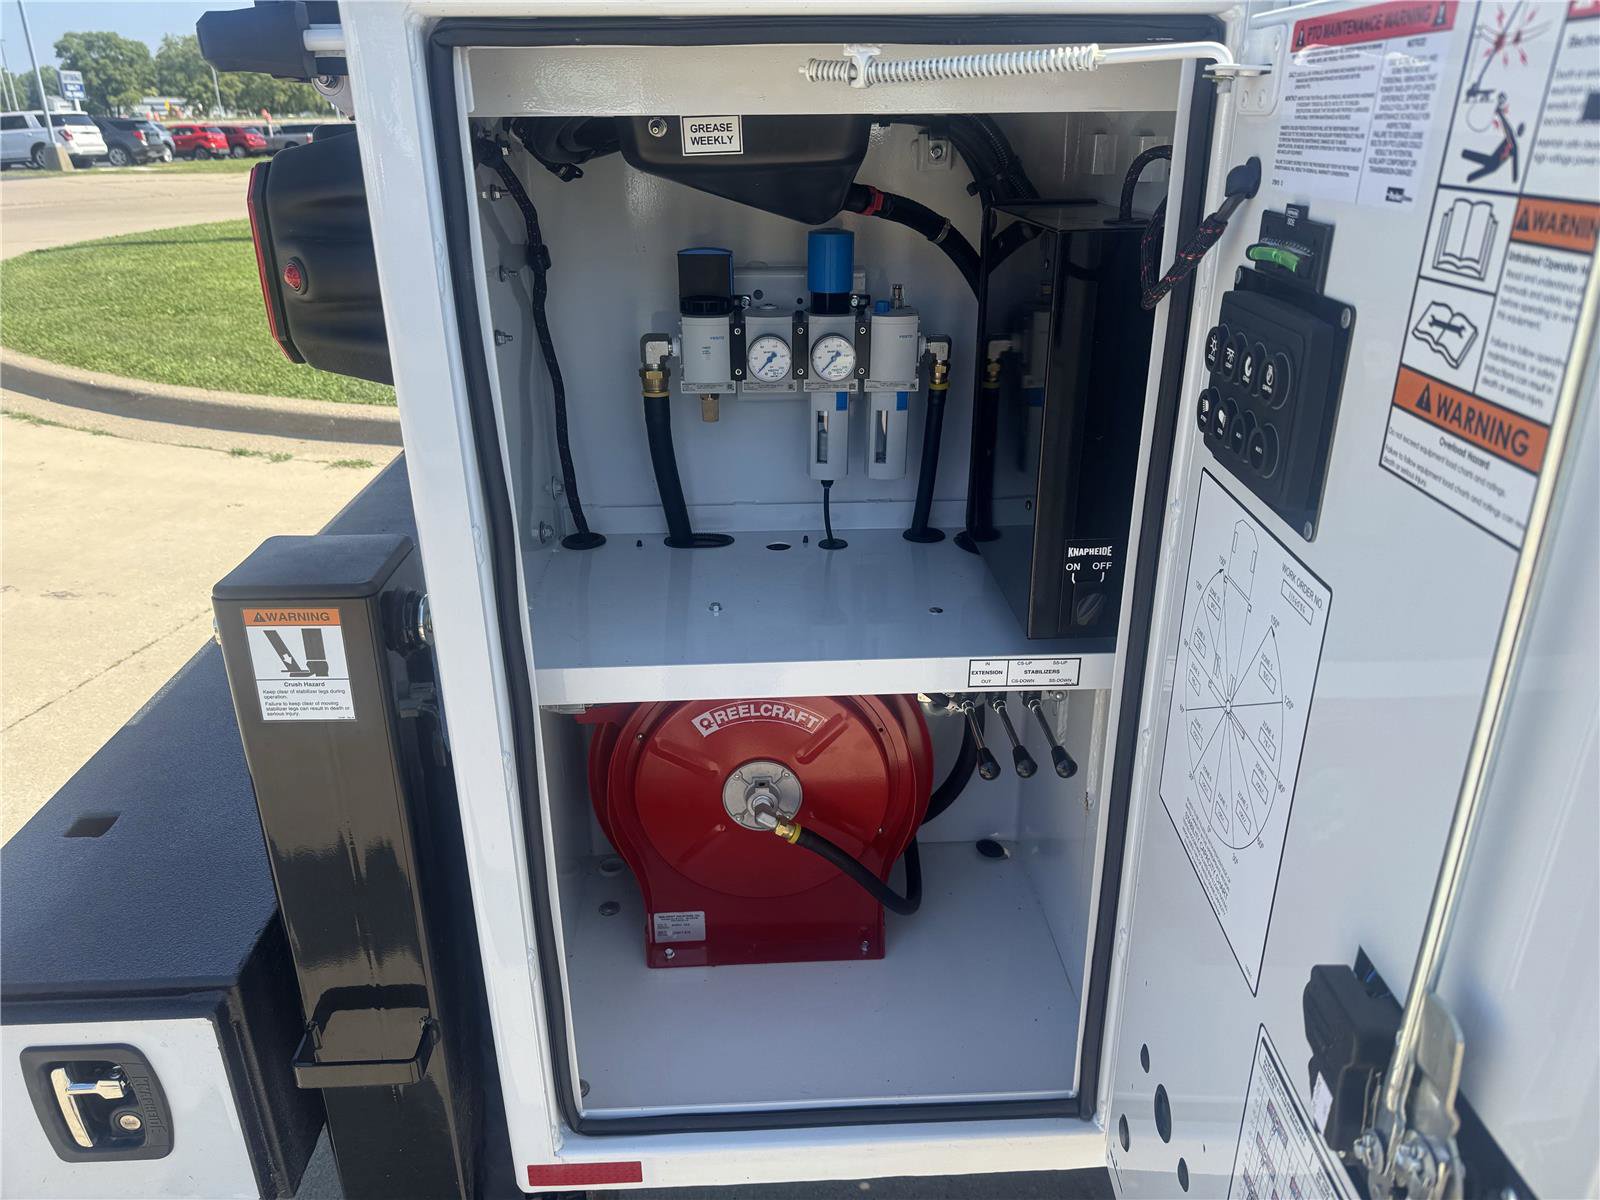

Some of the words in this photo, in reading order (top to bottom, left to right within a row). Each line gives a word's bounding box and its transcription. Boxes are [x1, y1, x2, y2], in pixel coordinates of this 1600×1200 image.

[1321, 14, 1383, 38] MAINTENANCE
[690, 123, 734, 134] GREASE
[690, 136, 734, 146] WEEKLY
[1436, 392, 1529, 457] WARNING
[1438, 435, 1466, 458] Overload
[1466, 450, 1490, 471] Hazard
[1067, 545, 1113, 558] KNAPHEIDE
[1065, 562, 1081, 571] ON
[1092, 561, 1113, 570] OFF
[1281, 561, 1296, 584] WORK
[1296, 576, 1314, 601] ORDER
[266, 612, 330, 622] WARNING
[1023, 668, 1061, 676] STABILIZERS
[713, 703, 820, 730] REELCRAFT
